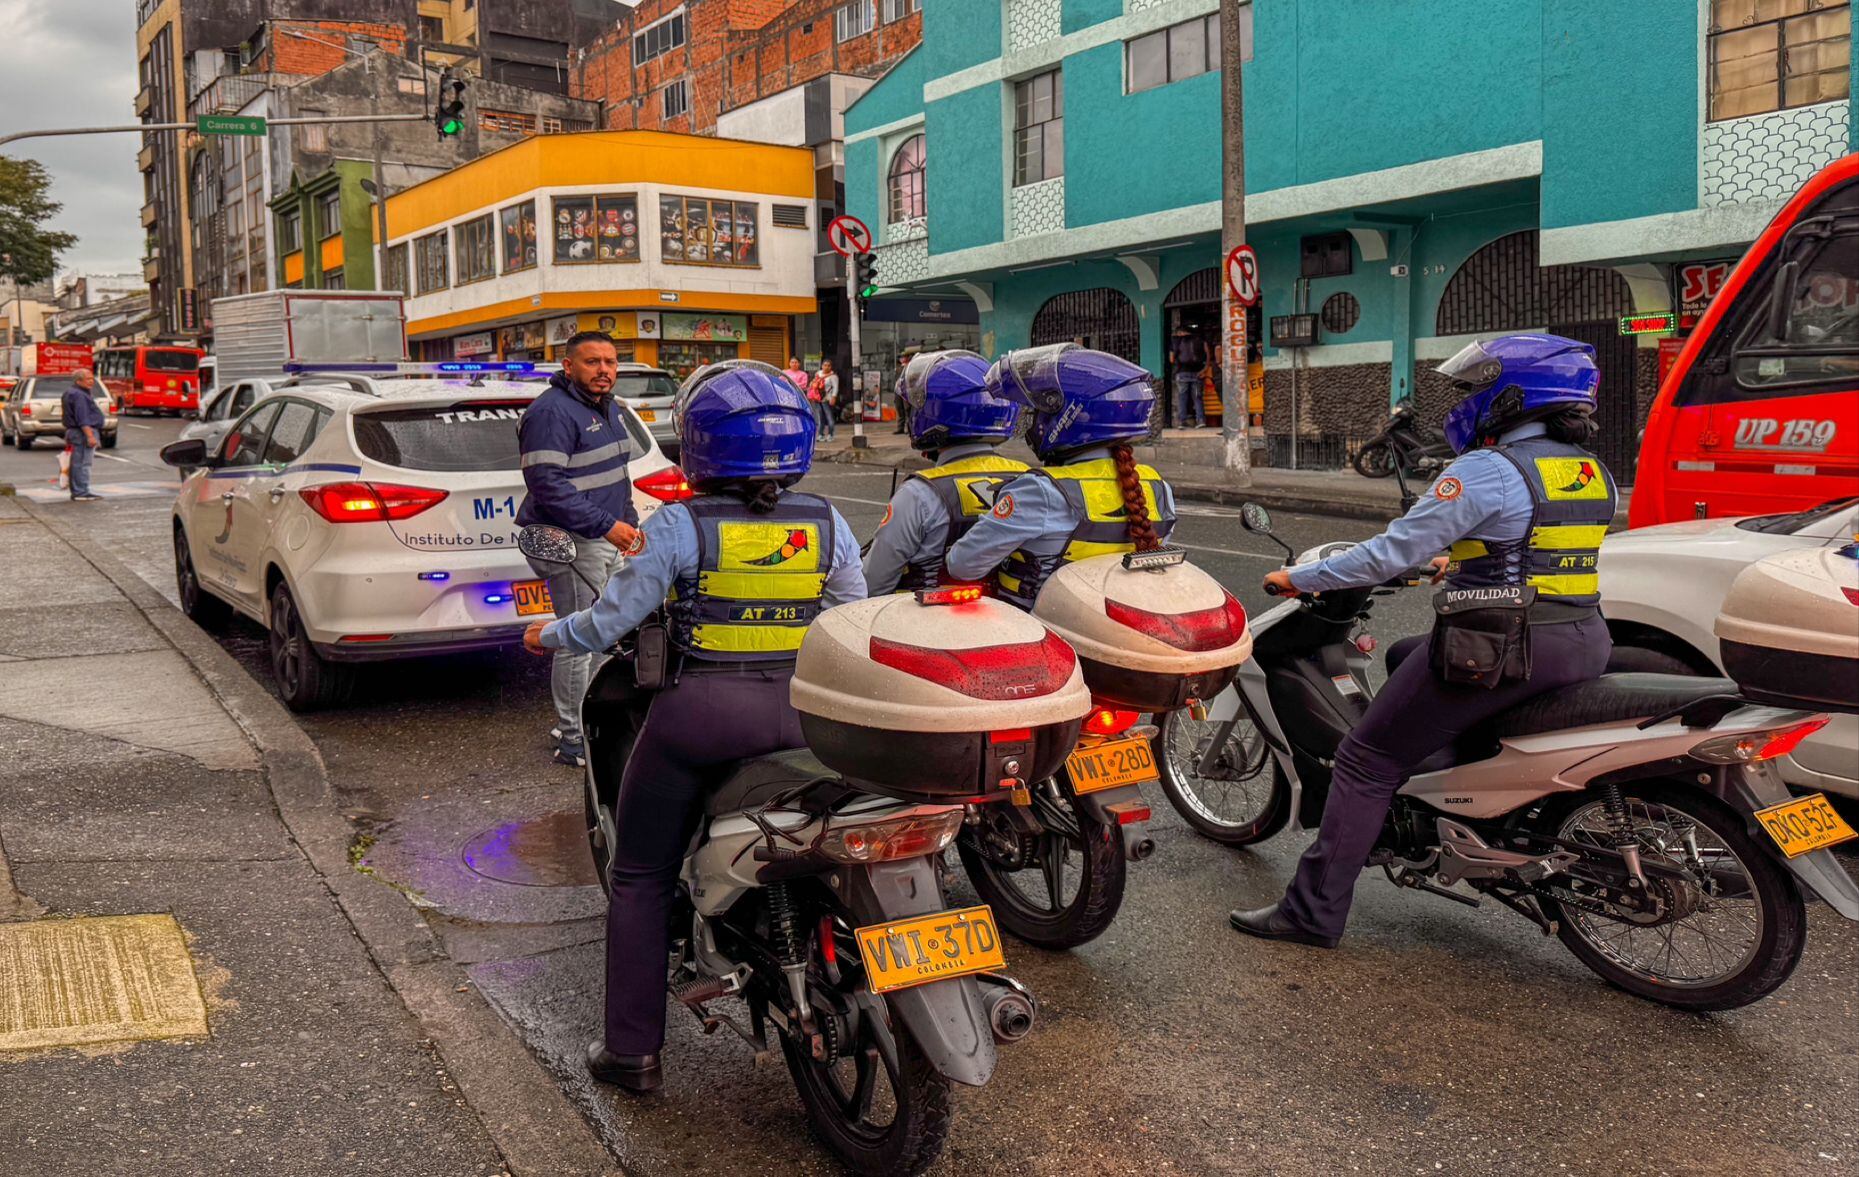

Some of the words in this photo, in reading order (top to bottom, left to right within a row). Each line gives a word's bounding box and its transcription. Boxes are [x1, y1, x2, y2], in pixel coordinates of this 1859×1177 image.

[206, 120, 245, 130] Carrera
[250, 122, 257, 130] 6
[1681, 262, 1735, 302] SE
[1682, 302, 1699, 310] Todo
[1048, 398, 1077, 444] SHAFT
[1734, 418, 1778, 444] UP
[1780, 419, 1836, 446] 159
[405, 532, 474, 546] Instituto
[480, 532, 504, 545] De
[1559, 557, 1577, 568] AT
[1446, 587, 1520, 603] MOVILIDAD
[741, 608, 765, 620] AT
[774, 607, 796, 619] 213
[917, 959, 966, 975] COLOMBIA
